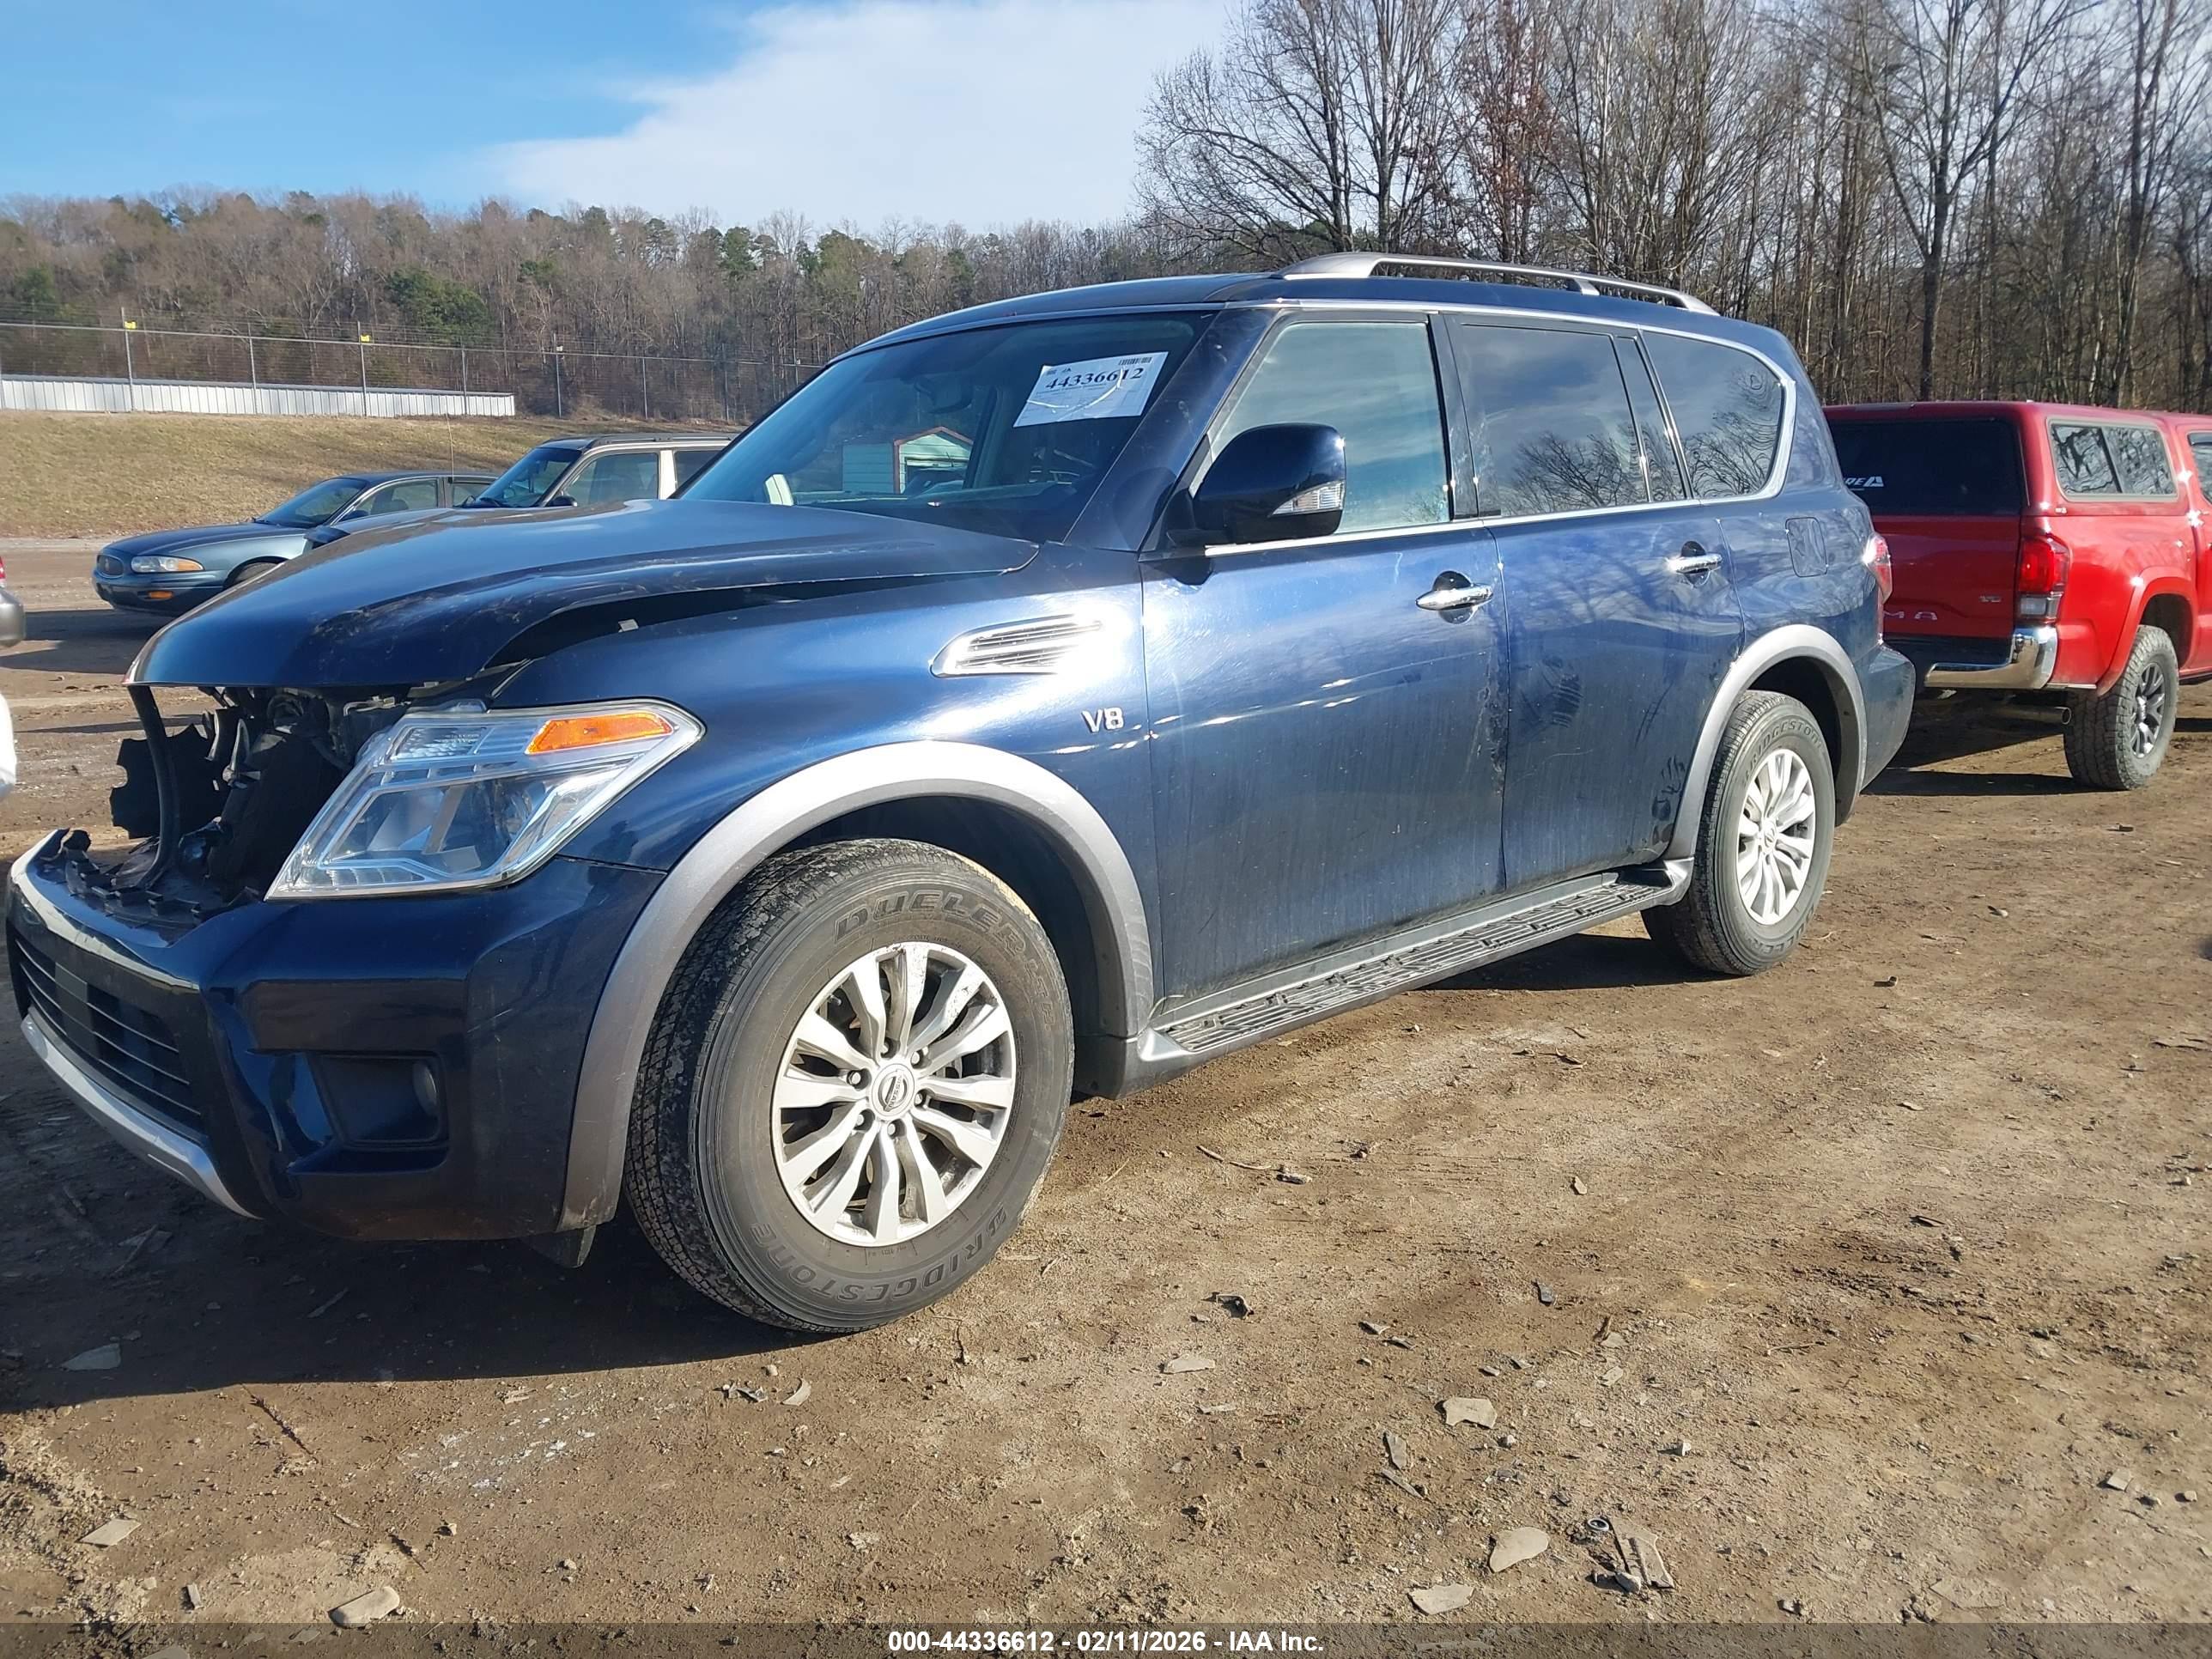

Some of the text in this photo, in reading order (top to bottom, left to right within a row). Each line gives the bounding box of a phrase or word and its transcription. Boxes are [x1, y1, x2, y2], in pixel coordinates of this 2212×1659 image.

[1045, 368, 1144, 389] 44336612
[1081, 707, 1125, 732] V8
[835, 889, 1026, 962] DUELER
[749, 1204, 1007, 1304] BRIDGESTONE
